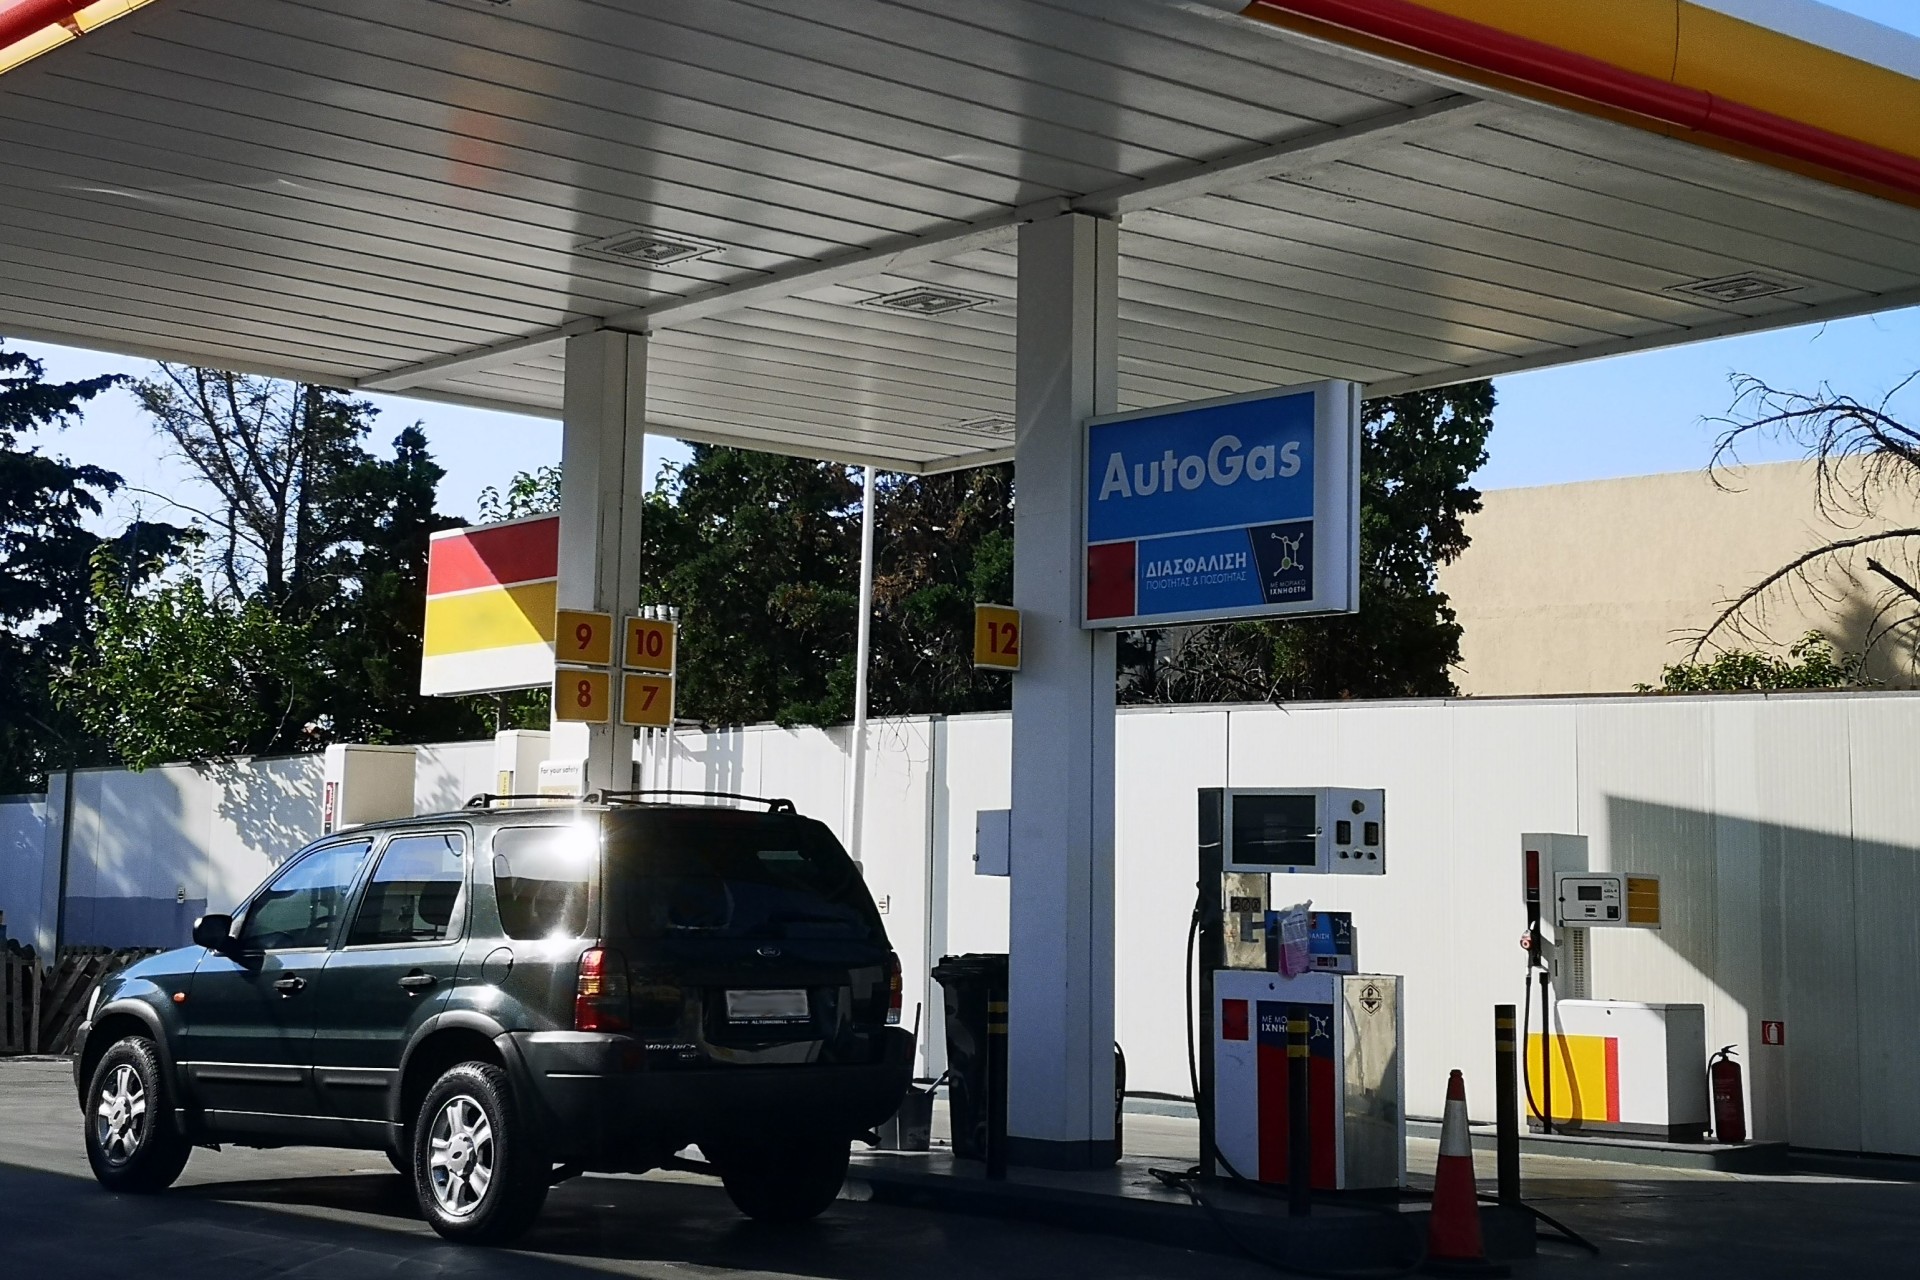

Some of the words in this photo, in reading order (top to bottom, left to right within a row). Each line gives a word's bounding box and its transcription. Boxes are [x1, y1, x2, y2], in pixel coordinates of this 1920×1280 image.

[1098, 435, 1302, 501] AutoGas
[1145, 552, 1247, 578] ΔΙΑΣΦΑΛΙΣΗ
[1146, 577, 1191, 590] ΠΟΙΟΤΗΤΑΣ
[1192, 576, 1199, 586] &
[1200, 571, 1247, 585] ΠΟΣΟΤΗΤΑΣ
[575, 623, 592, 650] 9
[635, 629, 663, 657] 10
[988, 622, 1018, 654] 12
[577, 680, 592, 708] 8
[641, 686, 659, 711] 7
[550, 768, 561, 776] your
[562, 766, 578, 774] safety
[1261, 1015, 1273, 1023] ΜΕ
[1274, 1015, 1288, 1024] ΜΟ
[1261, 1023, 1288, 1033] ΙΧΝΗ
